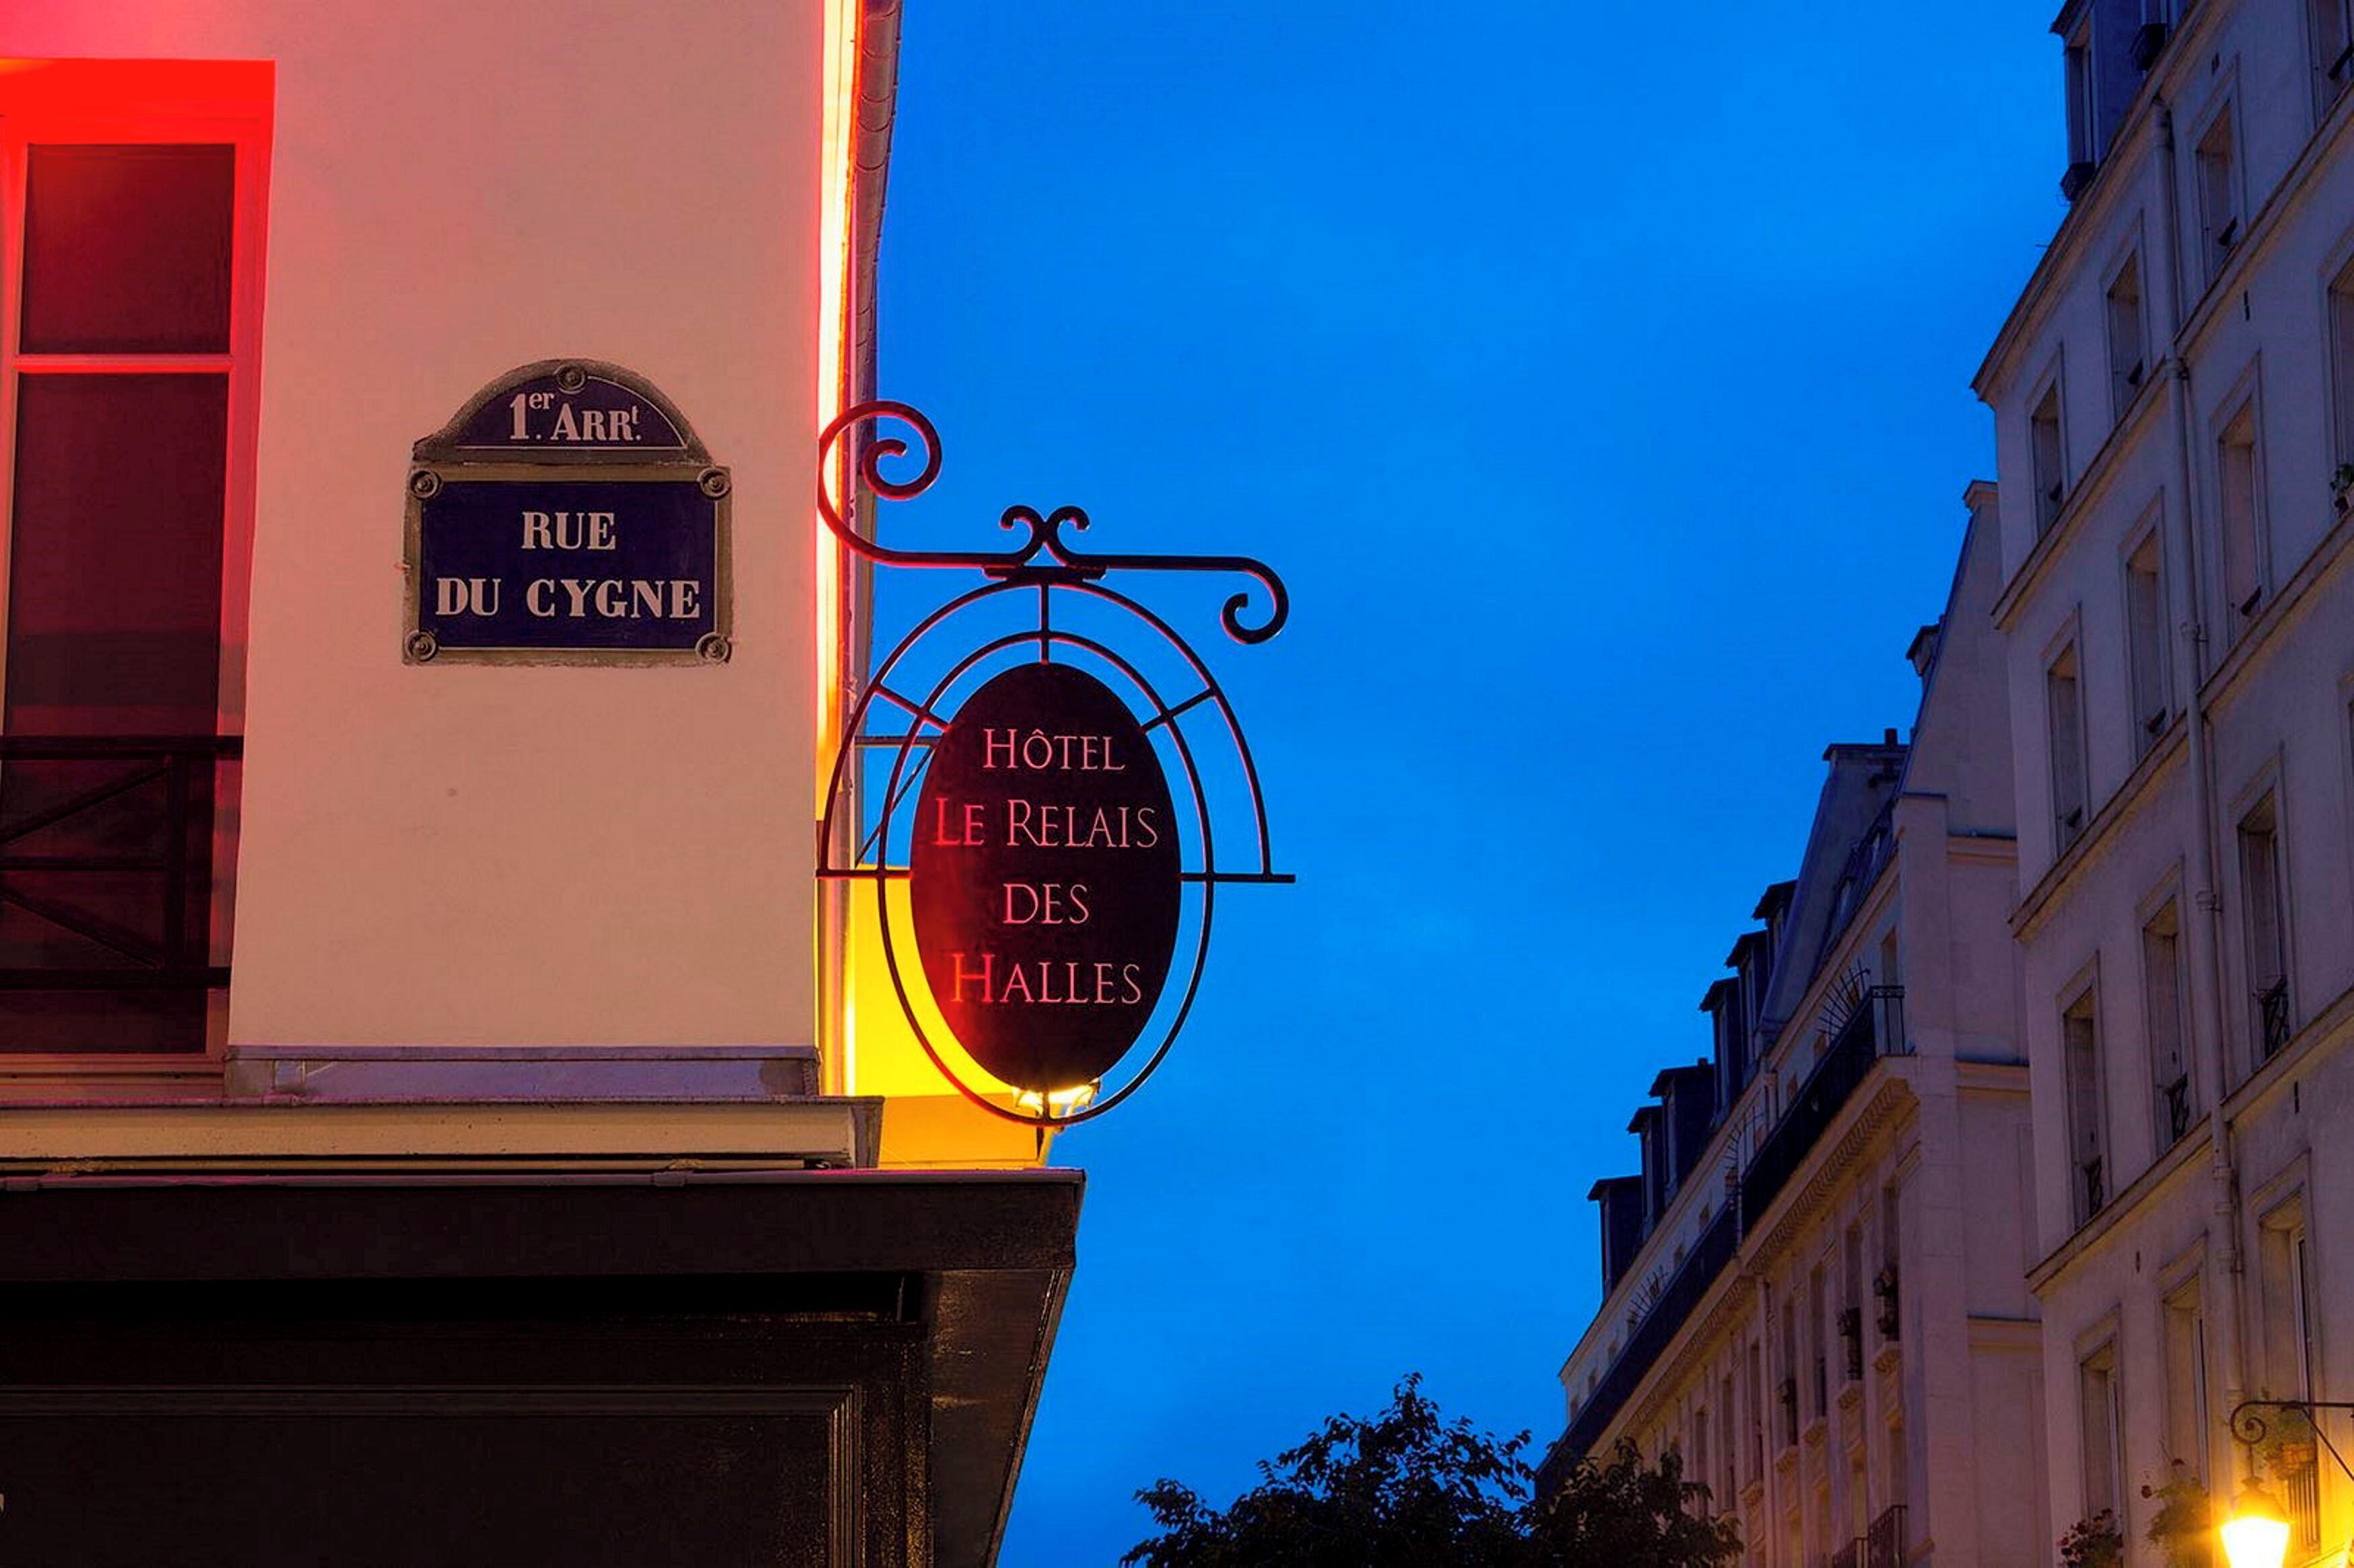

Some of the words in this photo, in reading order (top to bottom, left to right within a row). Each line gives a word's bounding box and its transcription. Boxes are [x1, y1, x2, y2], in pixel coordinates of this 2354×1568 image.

[521, 512, 616, 550] RUE
[436, 578, 502, 616] DU
[526, 579, 701, 619] CYGNE
[983, 728, 1126, 771] HÔTEL
[934, 798, 985, 846] LE
[1007, 799, 1158, 848] RELAIS
[1003, 883, 1089, 925] DES
[950, 953, 1141, 1005] HALLES
